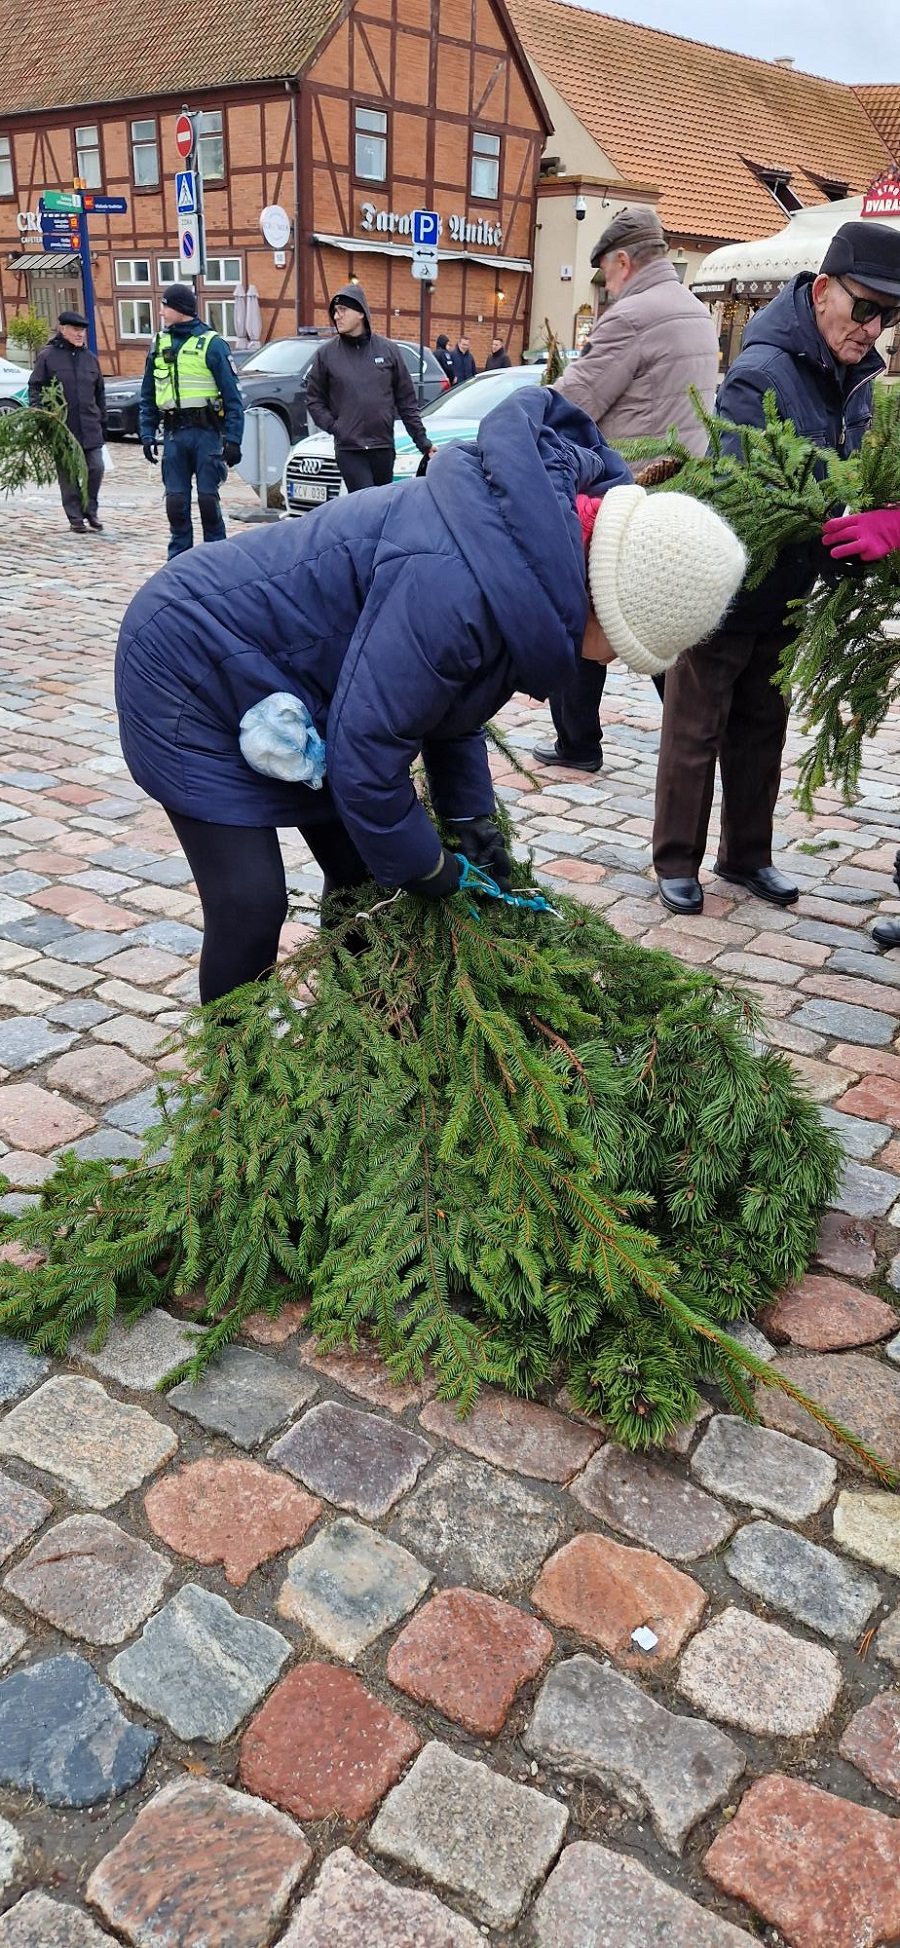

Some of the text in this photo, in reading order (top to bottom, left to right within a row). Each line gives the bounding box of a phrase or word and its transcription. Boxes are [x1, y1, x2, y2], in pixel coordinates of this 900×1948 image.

[865, 198, 900, 213] DVARA
[420, 215, 434, 241] P
[311, 487, 326, 500] 039
